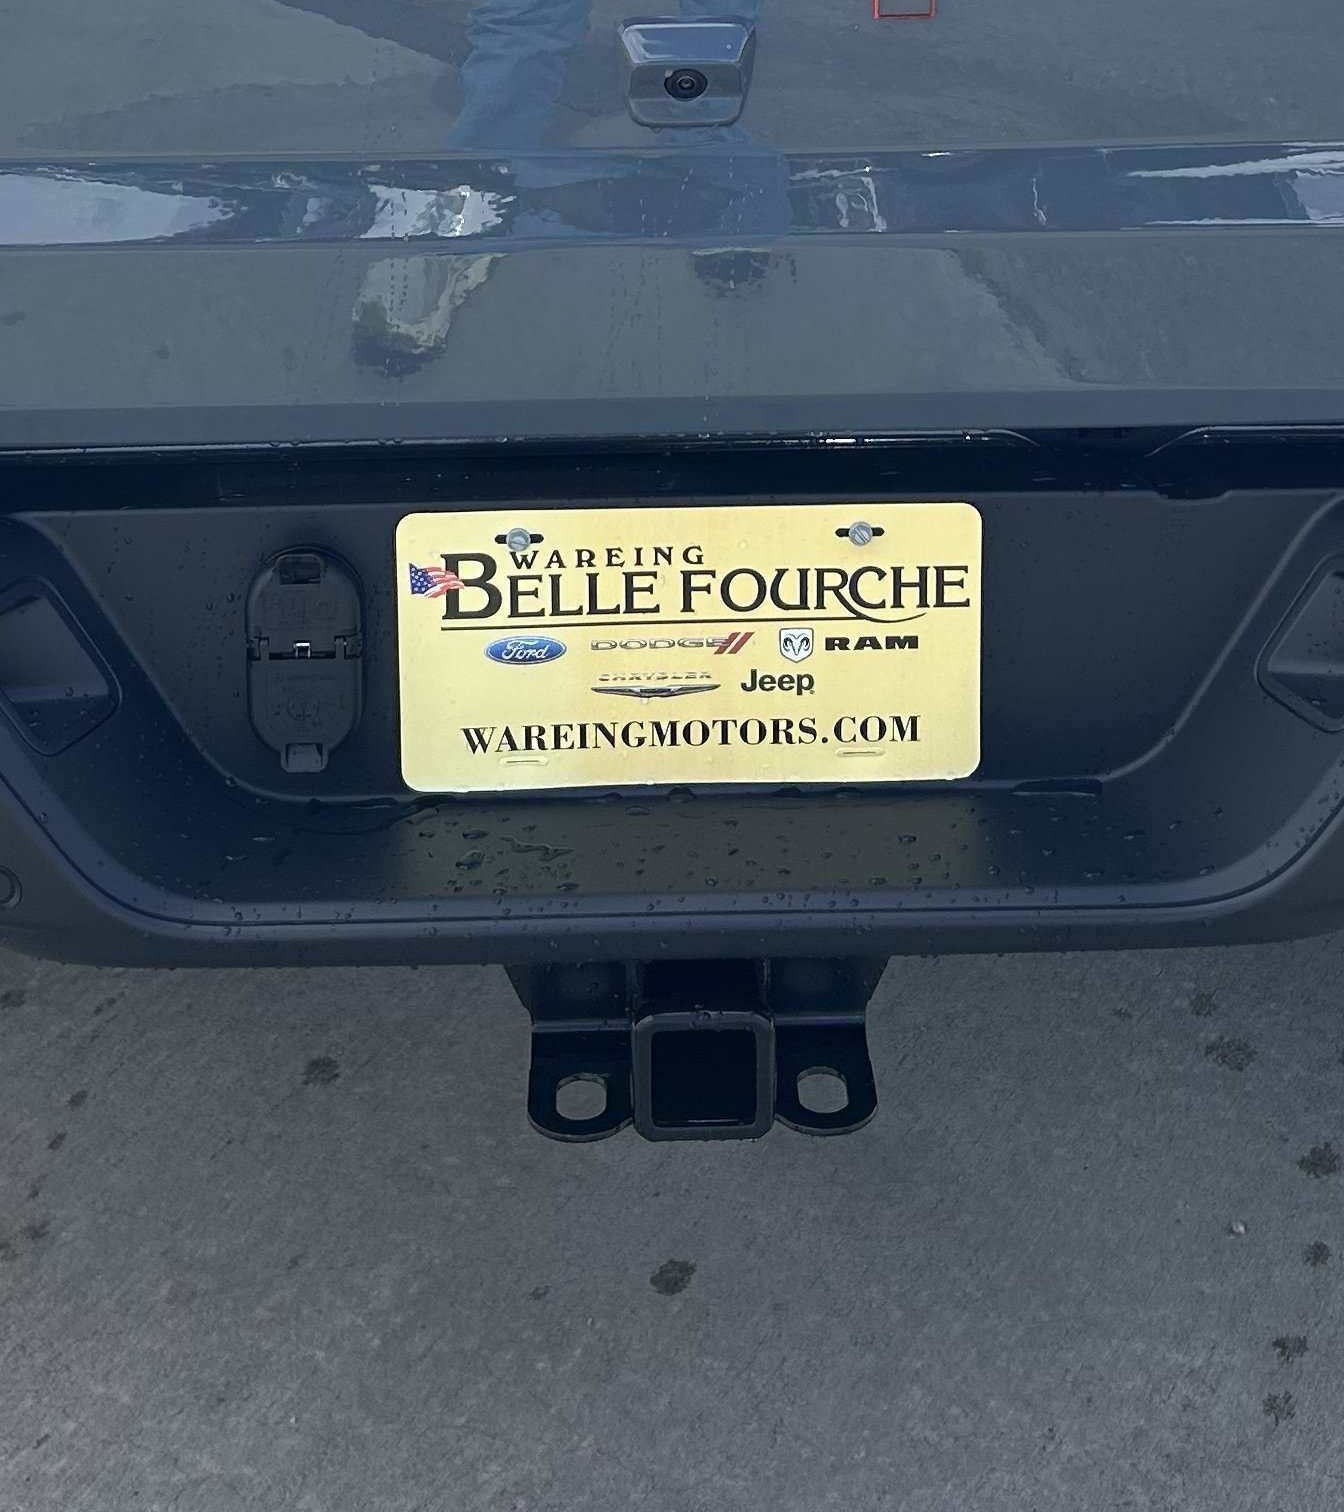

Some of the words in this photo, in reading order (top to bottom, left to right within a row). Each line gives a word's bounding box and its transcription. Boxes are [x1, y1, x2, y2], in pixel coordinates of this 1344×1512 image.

[509, 545, 706, 570] WAREING
[439, 552, 660, 621] BELLE
[679, 564, 972, 623] FOURCHE
[500, 640, 553, 663] Ford
[590, 637, 730, 651] DODGE
[824, 635, 919, 651] RAM
[598, 671, 713, 682] CHRYSLER
[740, 668, 815, 696] Jeep
[461, 714, 921, 755] WAREINGMOTORS.COM
